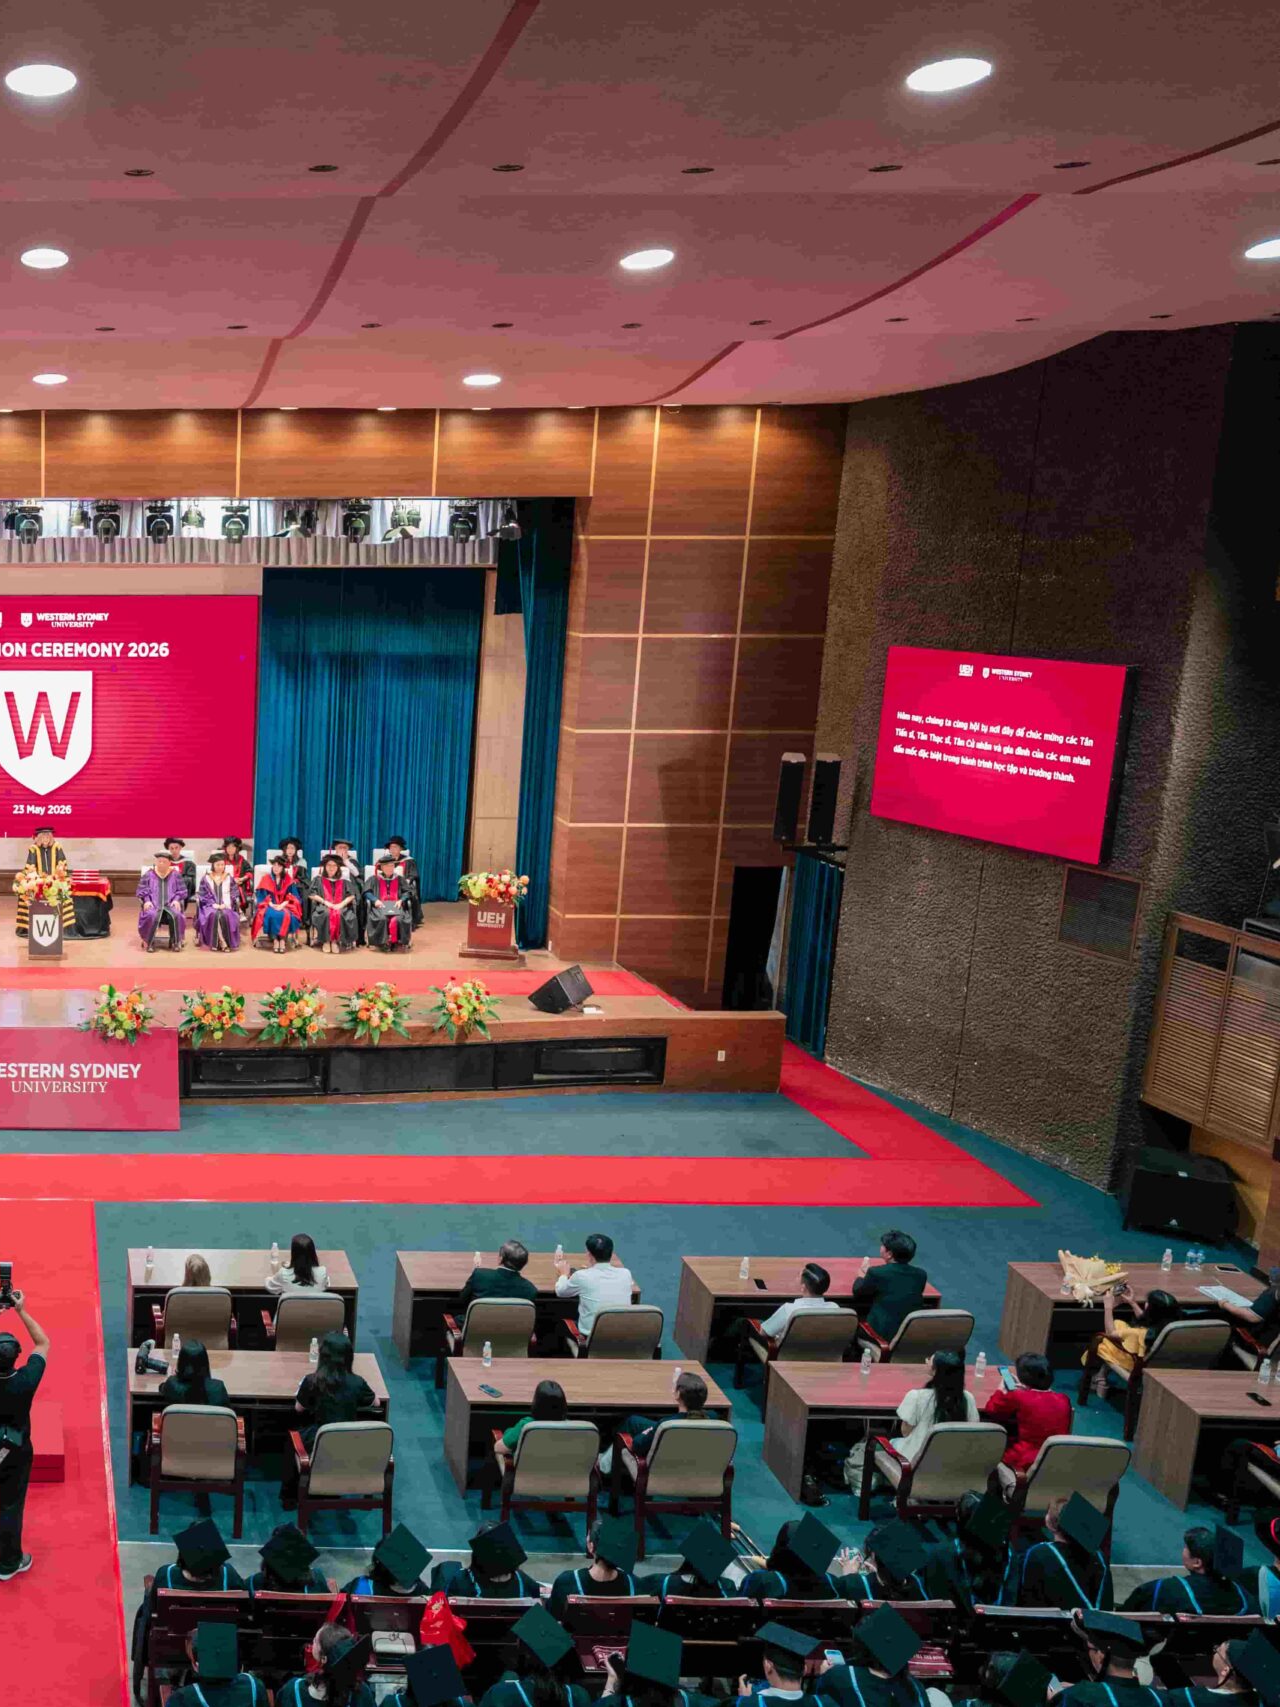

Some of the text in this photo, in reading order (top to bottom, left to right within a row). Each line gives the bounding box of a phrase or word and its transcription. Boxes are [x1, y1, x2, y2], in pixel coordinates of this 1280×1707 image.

[36, 612, 75, 621] WESTERN
[76, 612, 109, 621] SYDNEY
[31, 642, 124, 658] CEREMONY
[128, 642, 170, 658] 2026
[4, 691, 81, 760] W
[1066, 735, 1078, 744] các
[1046, 752, 1058, 761] các
[13, 804, 72, 817] 23 May 2026
[477, 911, 505, 925] UEH
[36, 918, 57, 937] W
[69, 1063, 142, 1079] SYDNEY
[10, 1081, 108, 1093] UNIVERSITY
